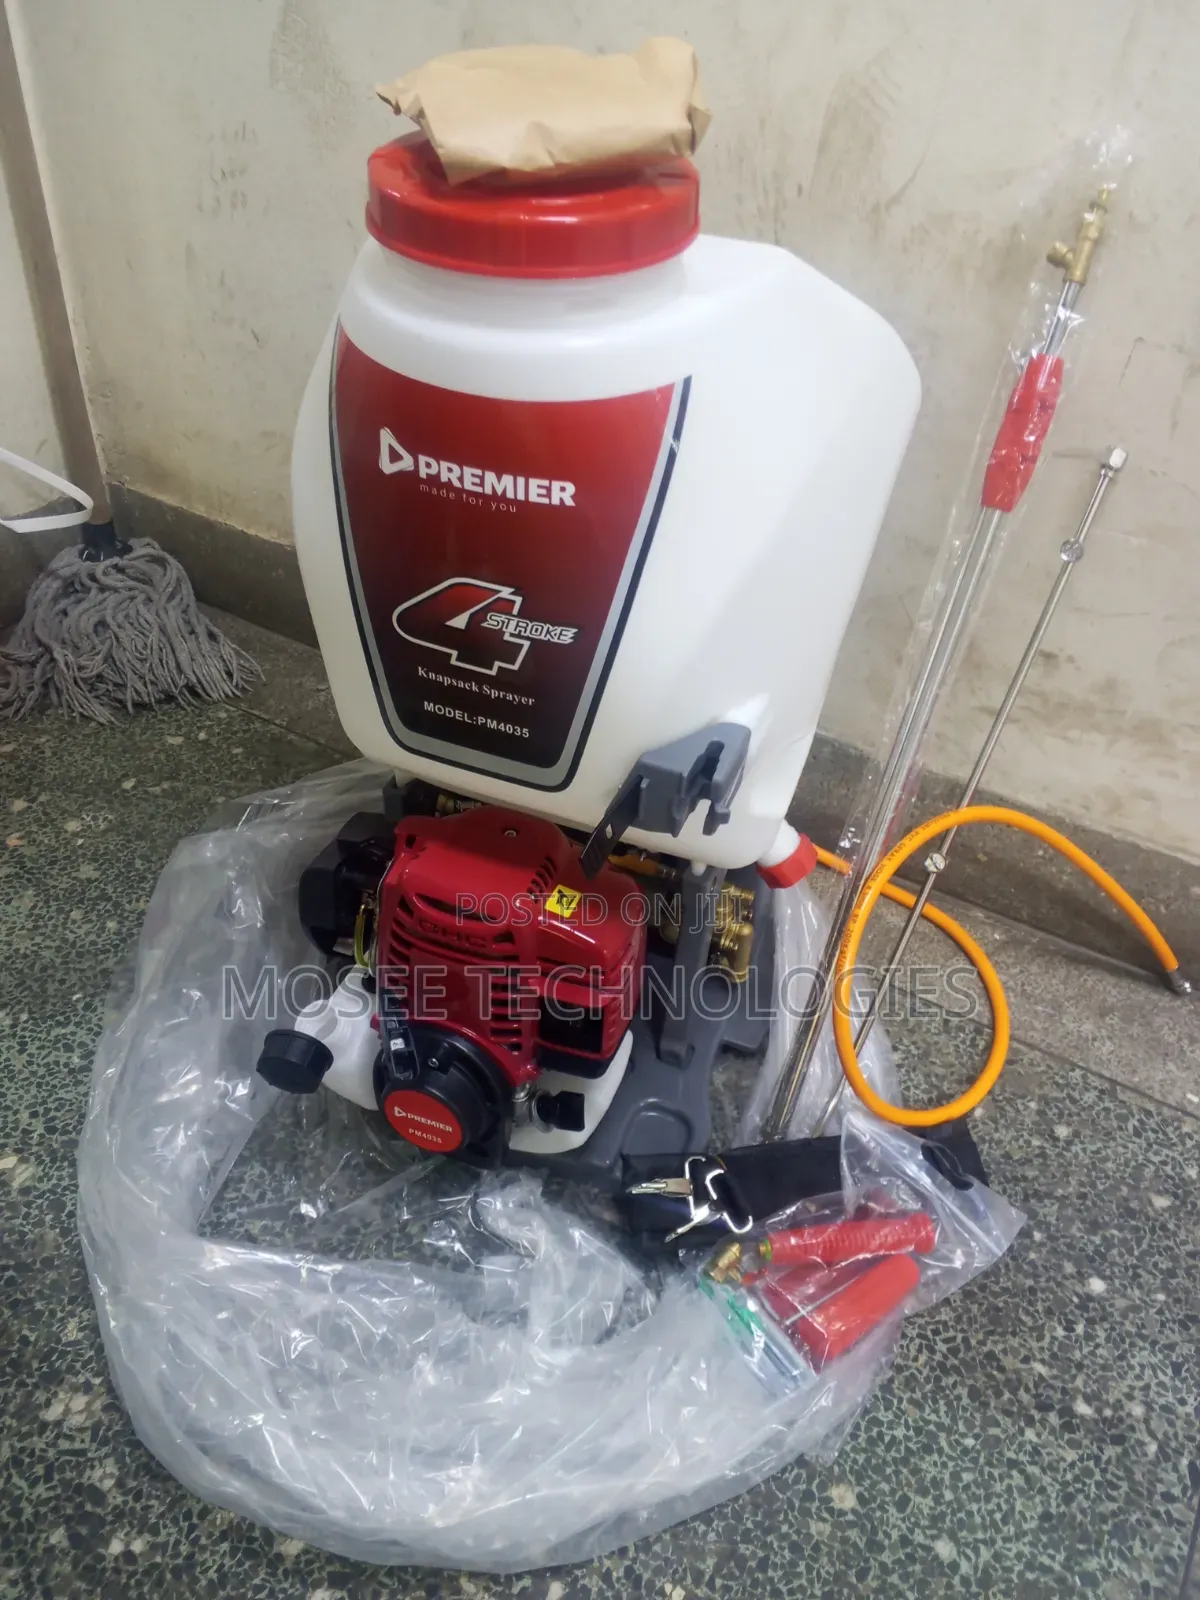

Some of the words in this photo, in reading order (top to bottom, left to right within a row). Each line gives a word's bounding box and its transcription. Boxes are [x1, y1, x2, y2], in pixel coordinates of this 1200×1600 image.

[418, 454, 576, 506] PREMIER
[419, 483, 456, 501] made
[463, 492, 484, 507] for
[490, 500, 517, 514] you
[392, 577, 531, 675] 4
[481, 612, 578, 644] STROKE
[417, 666, 480, 694] Knapsack
[482, 684, 536, 706] Sprayer
[424, 700, 531, 738] MODEL:PM4035
[407, 1113, 453, 1133] PREMIER
[408, 1128, 442, 1144] PM4035
